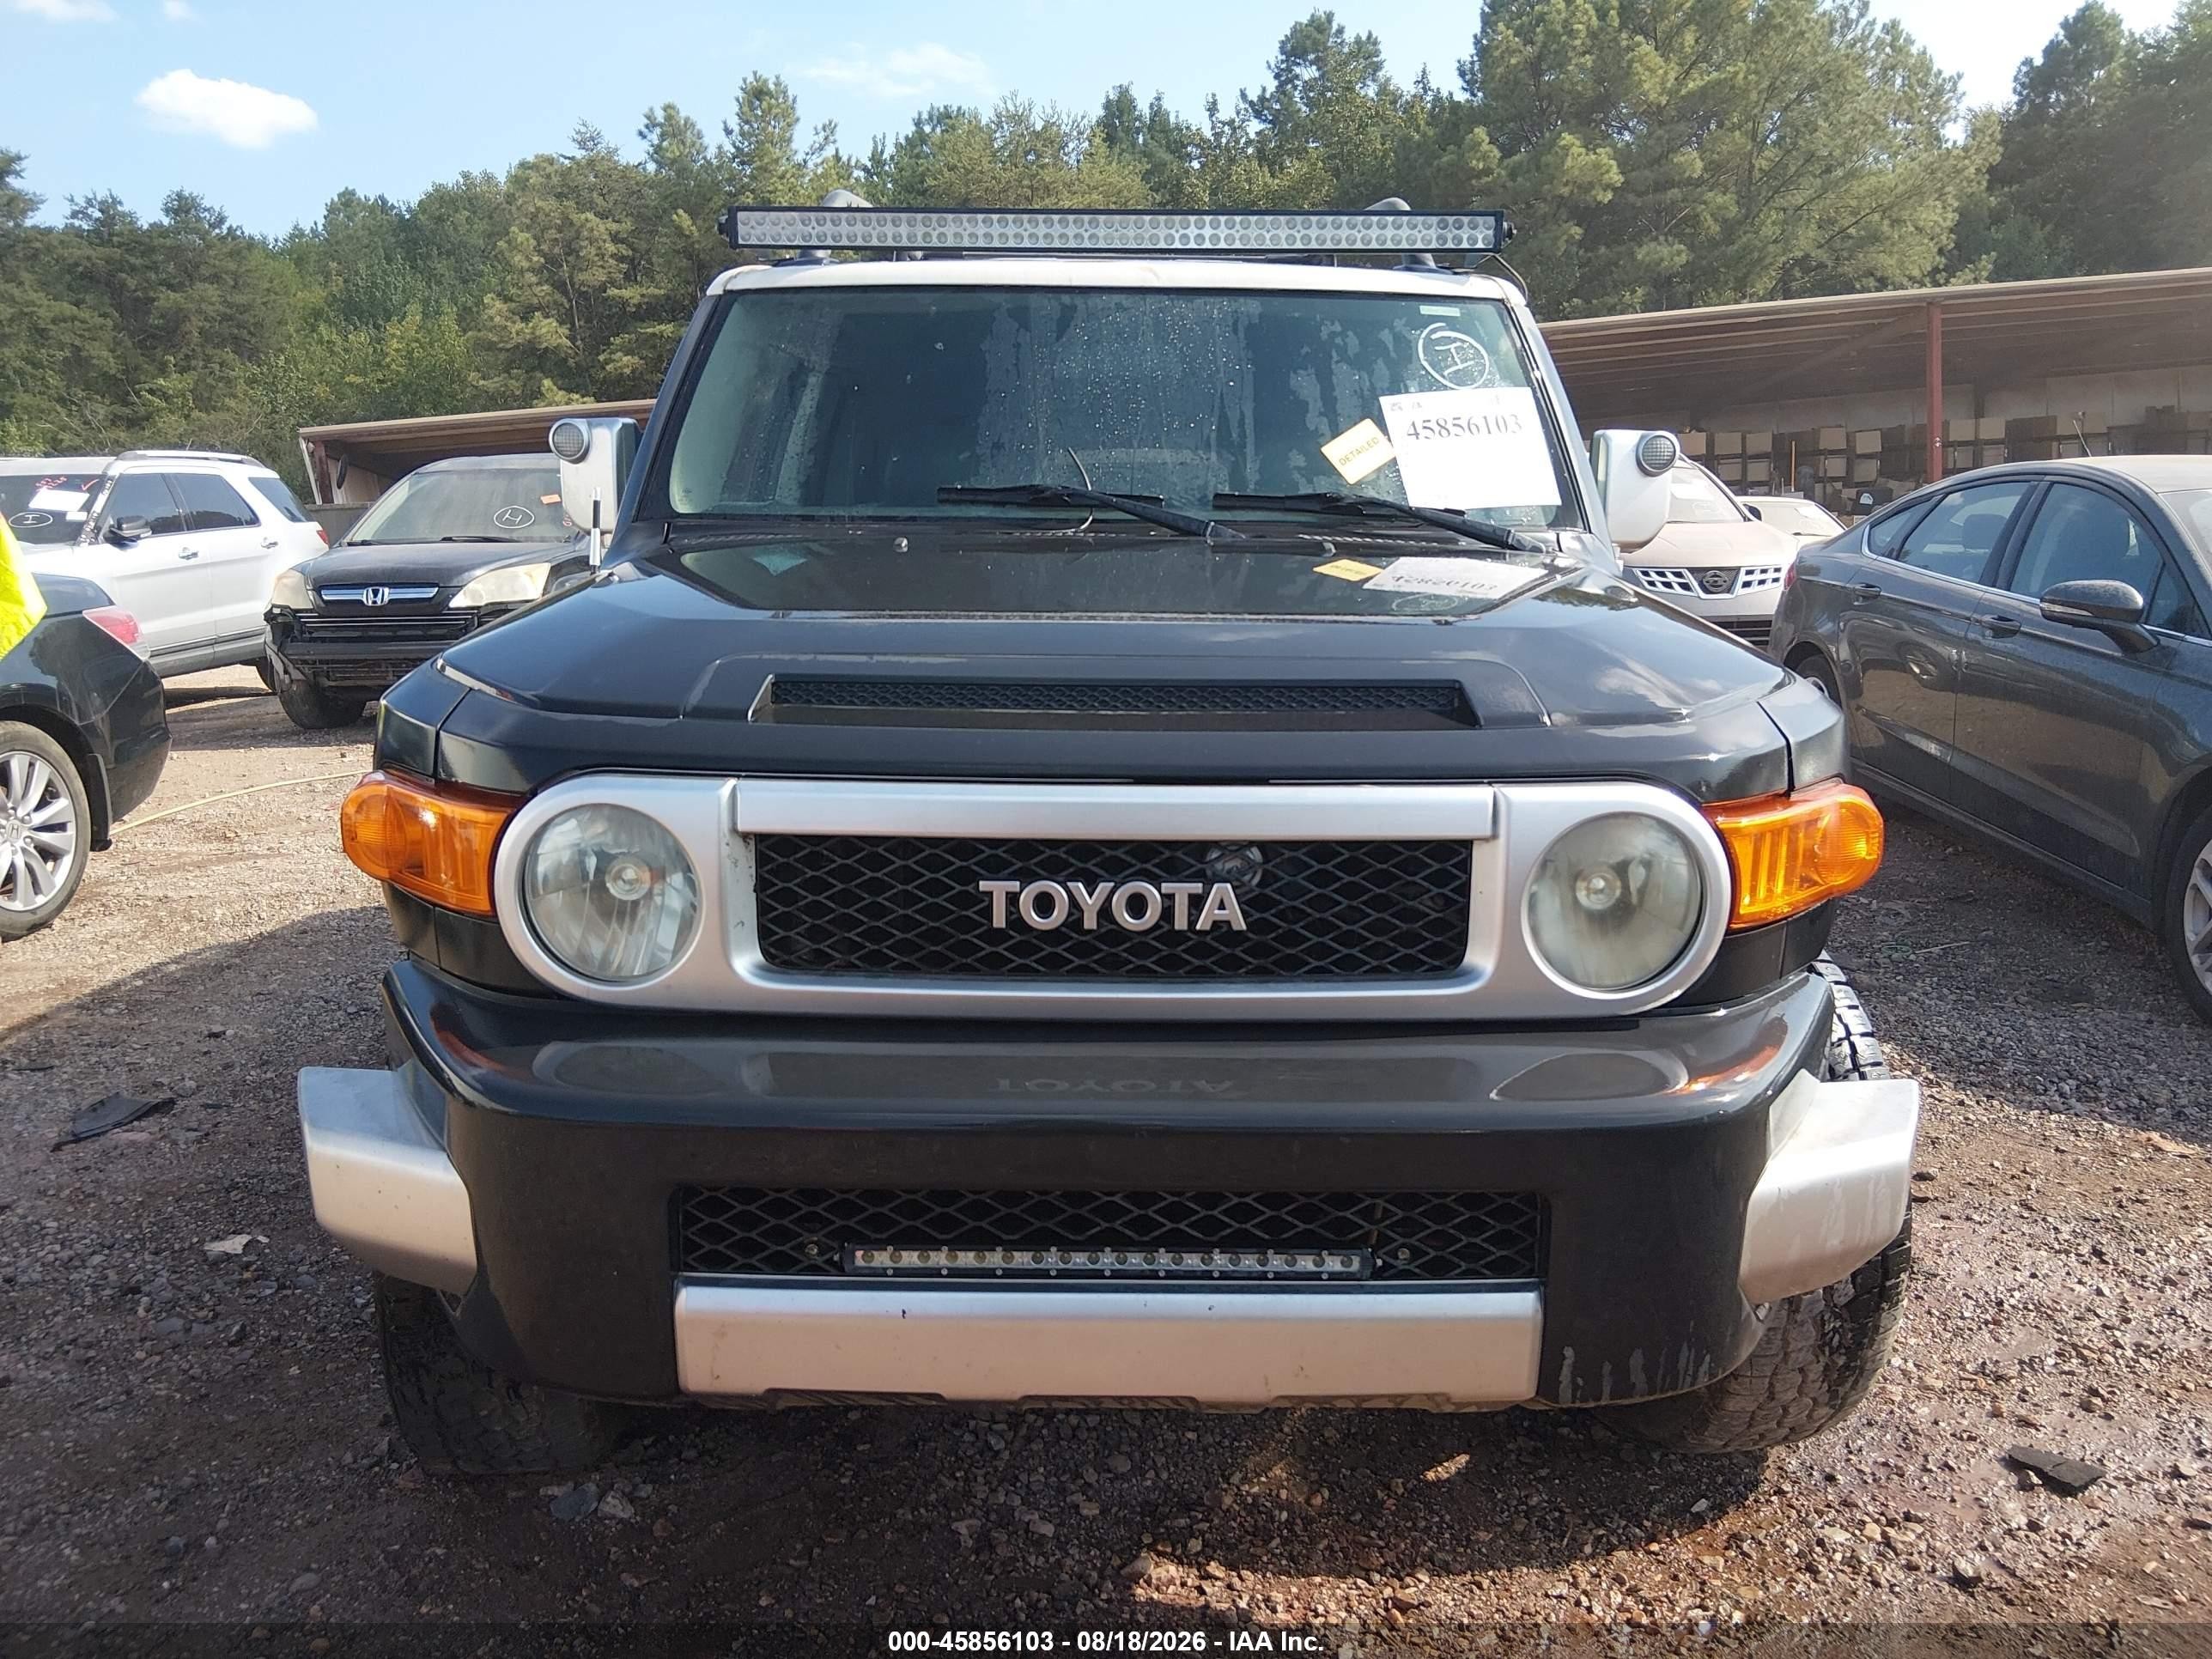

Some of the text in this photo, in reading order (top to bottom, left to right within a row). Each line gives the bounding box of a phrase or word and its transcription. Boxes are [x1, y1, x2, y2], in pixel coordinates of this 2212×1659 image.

[1406, 414, 1522, 441] 45856103
[1339, 436, 1379, 466] DETAILED
[978, 879, 1247, 932] TOYOTA
